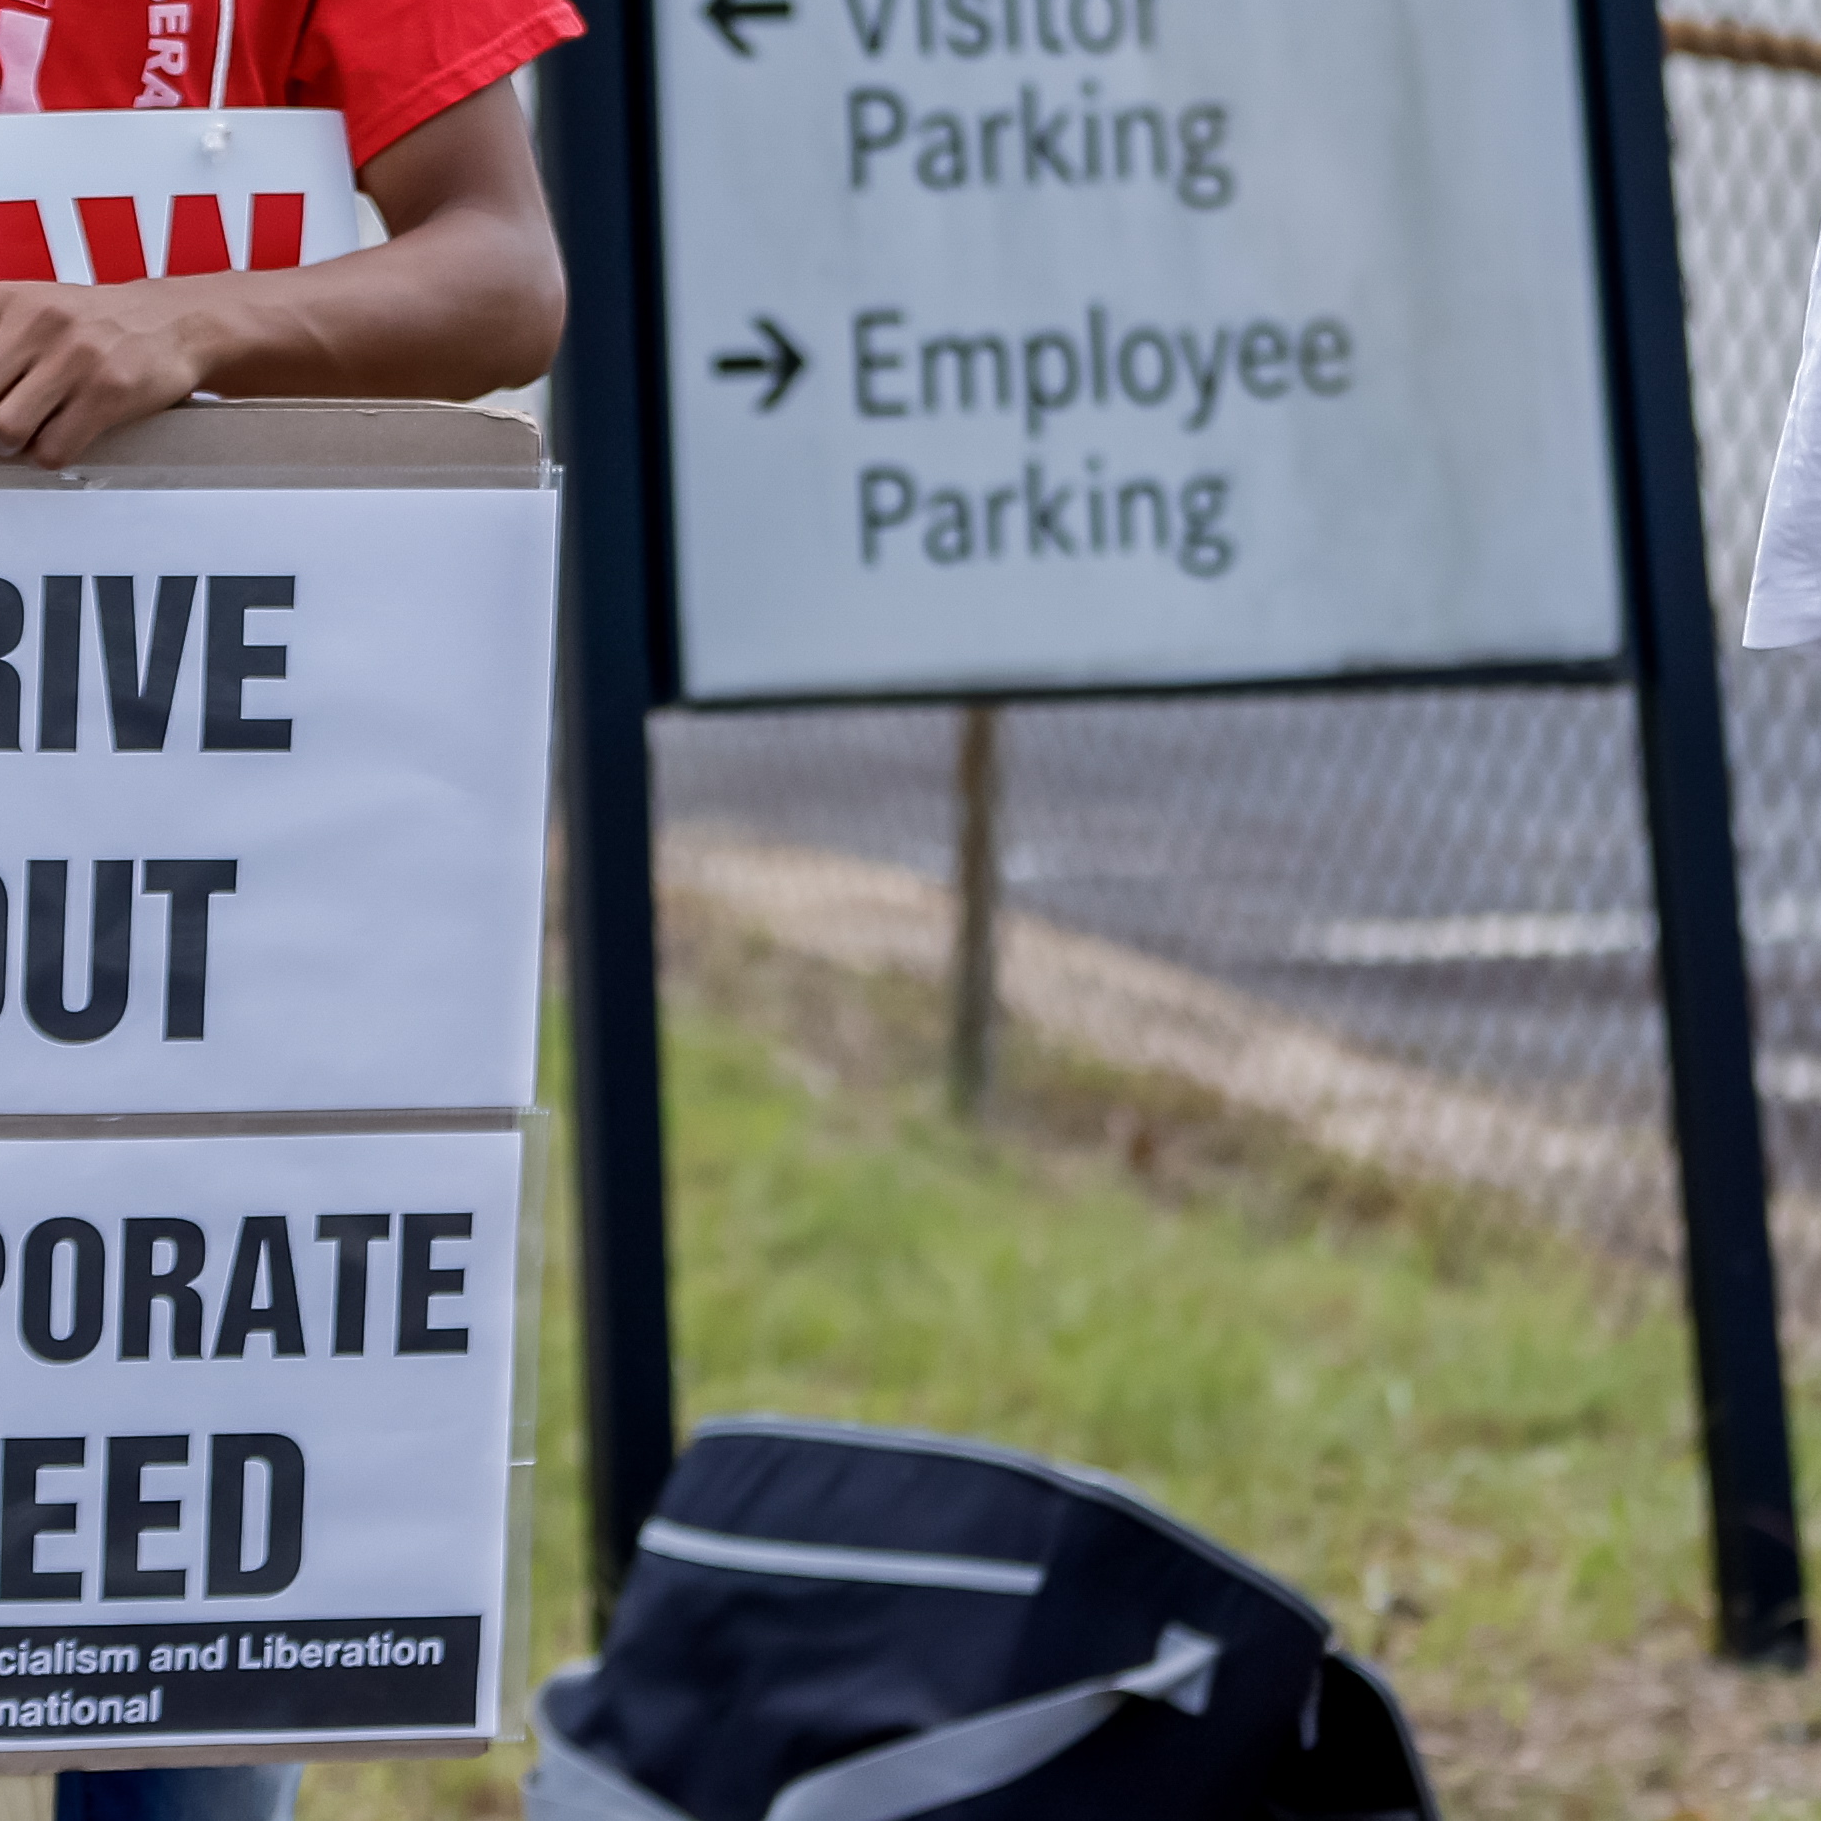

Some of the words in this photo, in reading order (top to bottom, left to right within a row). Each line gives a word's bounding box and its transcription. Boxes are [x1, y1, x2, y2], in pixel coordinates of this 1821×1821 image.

[844, 76, 1240, 213] Parking
[850, 305, 1355, 439] Employee
[856, 454, 1237, 582] Parking
[148, 1633, 229, 1673] and
[237, 1628, 446, 1671] Liberation
